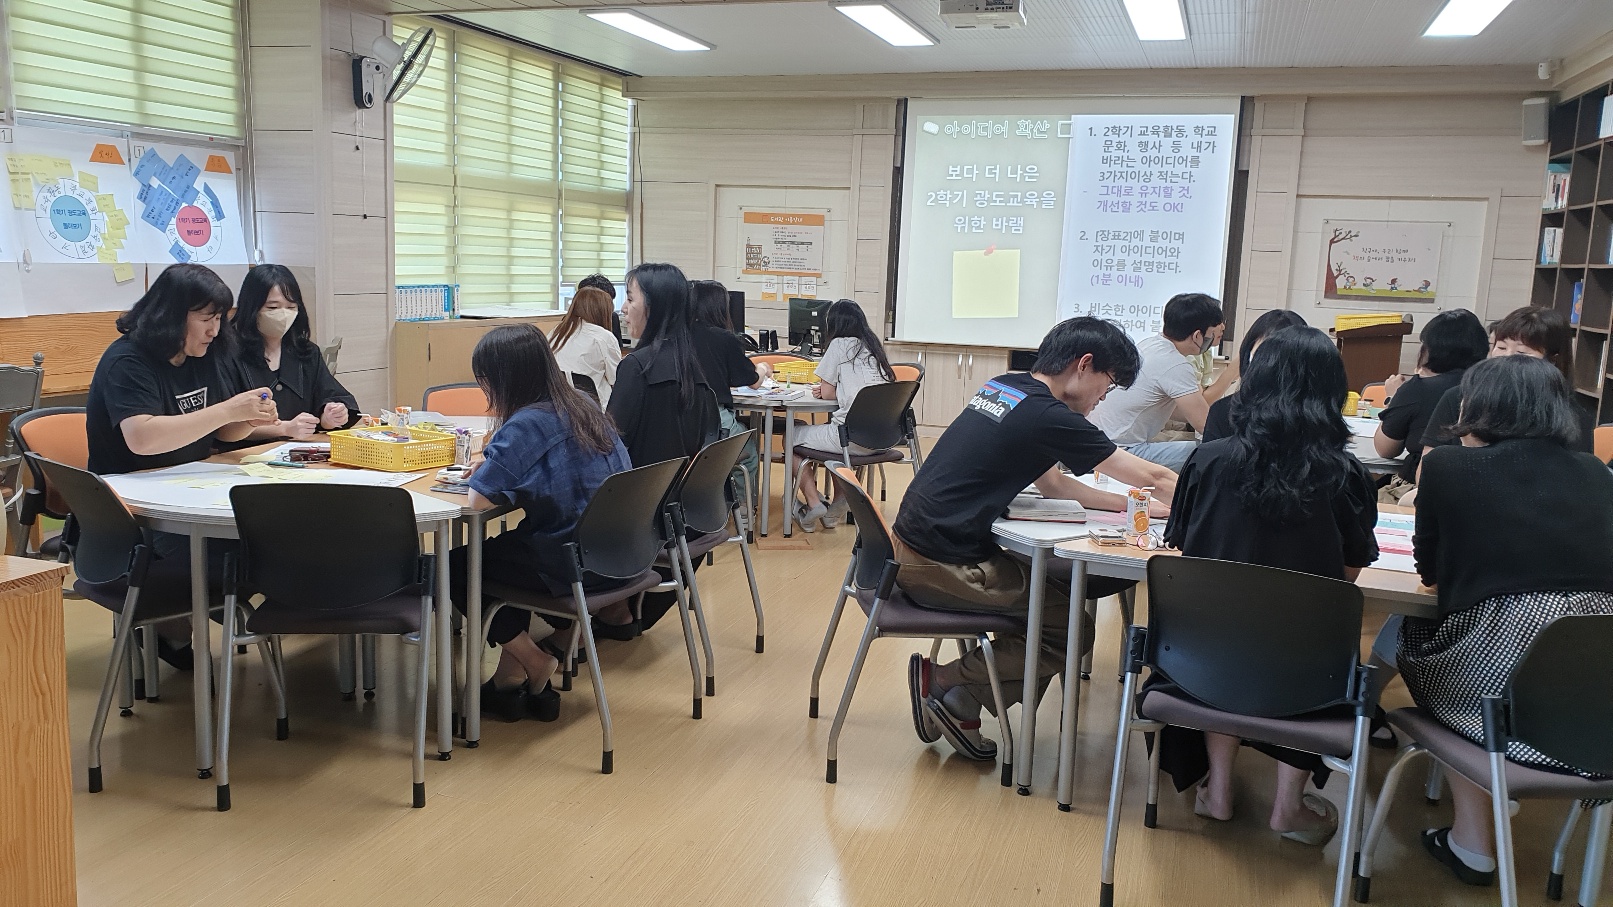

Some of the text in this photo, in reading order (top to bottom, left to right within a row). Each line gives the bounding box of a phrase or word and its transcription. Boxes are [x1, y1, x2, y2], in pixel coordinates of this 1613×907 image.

[944, 120, 1051, 139] 아이디어 확산
[1088, 125, 1218, 138] 1. 2학기 교육활동, 학교
[1102, 140, 1217, 154] 문화, 행사 등 내가
[1101, 155, 1202, 168] 바라는 아이디어를
[947, 164, 1040, 182] 보다 더 나은
[1098, 170, 1196, 184] 3가지이상 적는다.
[926, 190, 1057, 209] 2학기 광도교육을
[1098, 185, 1192, 200] 그대로 유지할 것,
[1096, 200, 1184, 214] 개선할 것도 OK!
[953, 216, 1025, 234] 위한 바램
[1079, 230, 1089, 240] 2.
[1148, 230, 1185, 244] 붙이며
[1092, 244, 1181, 259] 자기 아이디어와
[1092, 258, 1182, 274] 이유를 설명한다.
[1090, 273, 1144, 288] (1분 이내)
[1074, 302, 1164, 317] 3. 비슷한 아이디
